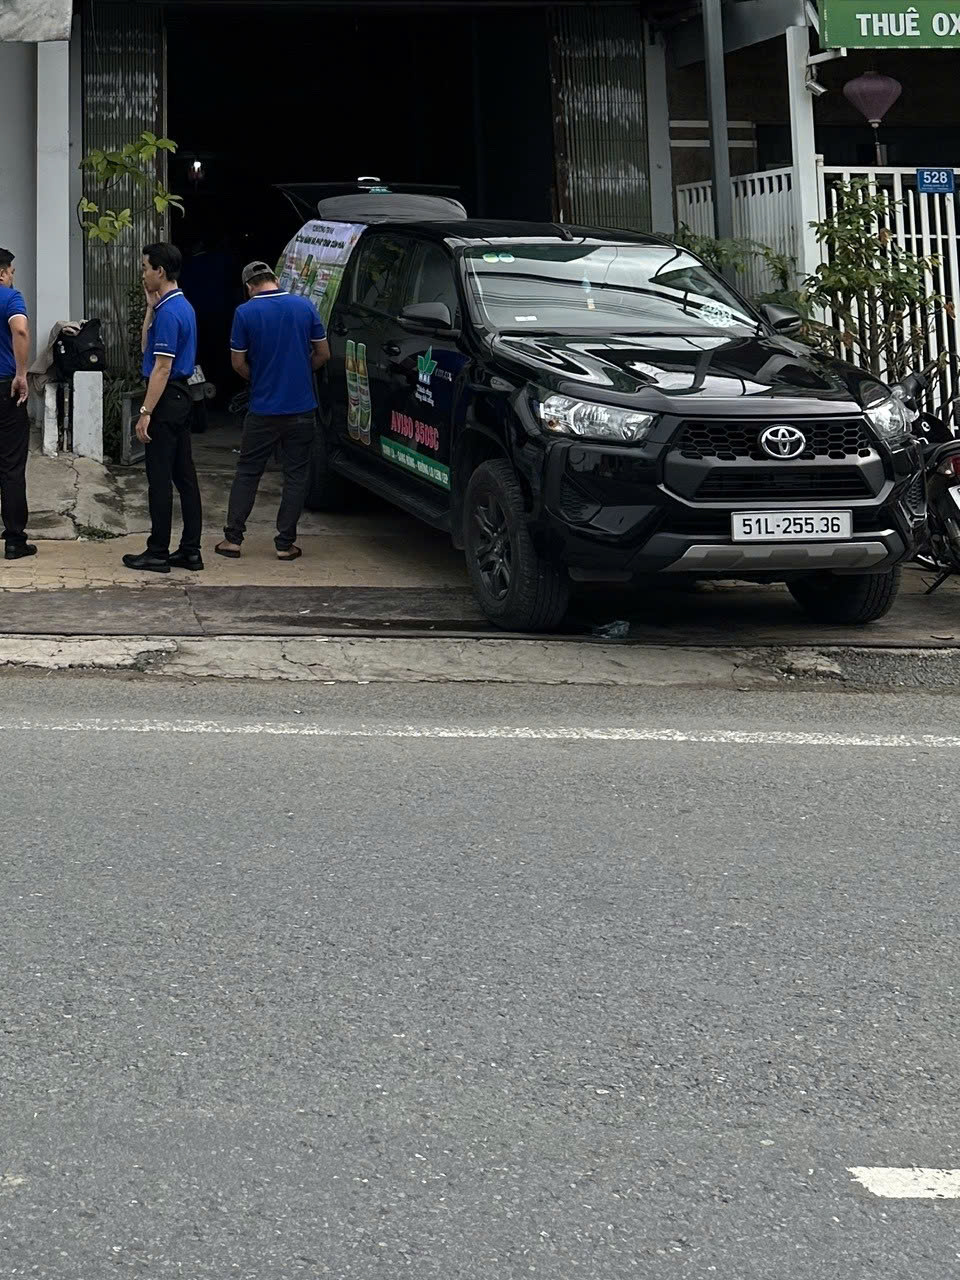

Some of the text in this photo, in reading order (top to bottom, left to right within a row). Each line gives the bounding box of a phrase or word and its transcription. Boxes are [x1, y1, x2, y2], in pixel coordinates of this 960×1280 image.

[856, 7, 920, 36] THUÊ
[923, 171, 948, 184] 528
[742, 517, 841, 535] 51L-255.36
